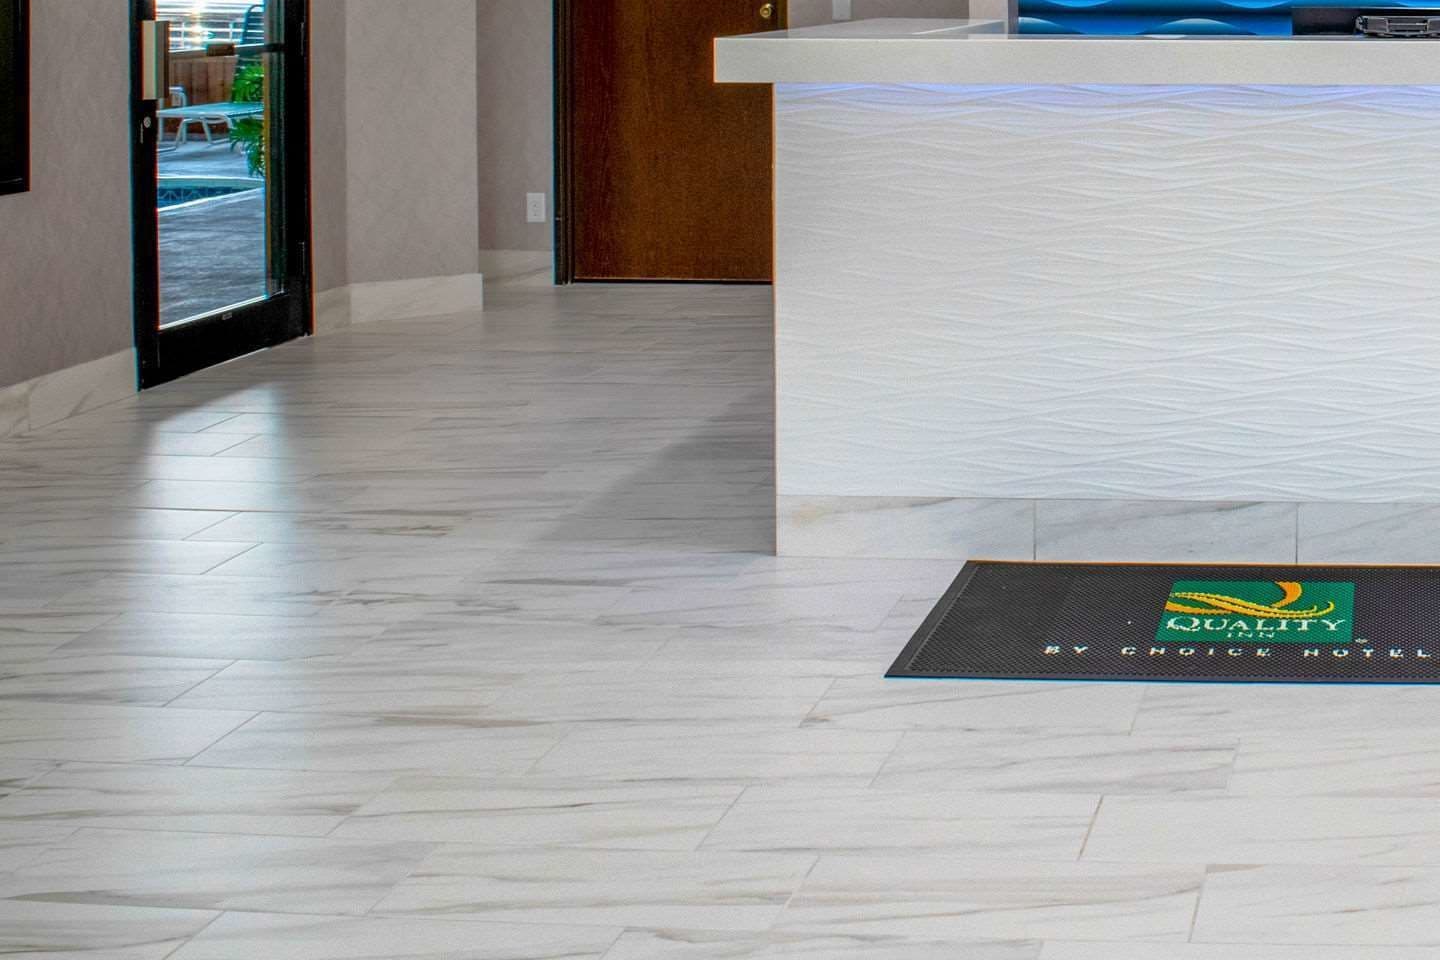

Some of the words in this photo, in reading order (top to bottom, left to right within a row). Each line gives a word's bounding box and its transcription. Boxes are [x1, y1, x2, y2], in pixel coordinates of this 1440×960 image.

[1166, 615, 1346, 633] QUALITY
[1226, 631, 1276, 639] INN
[1042, 644, 1089, 656] BY
[1120, 645, 1272, 658] CHOICE
